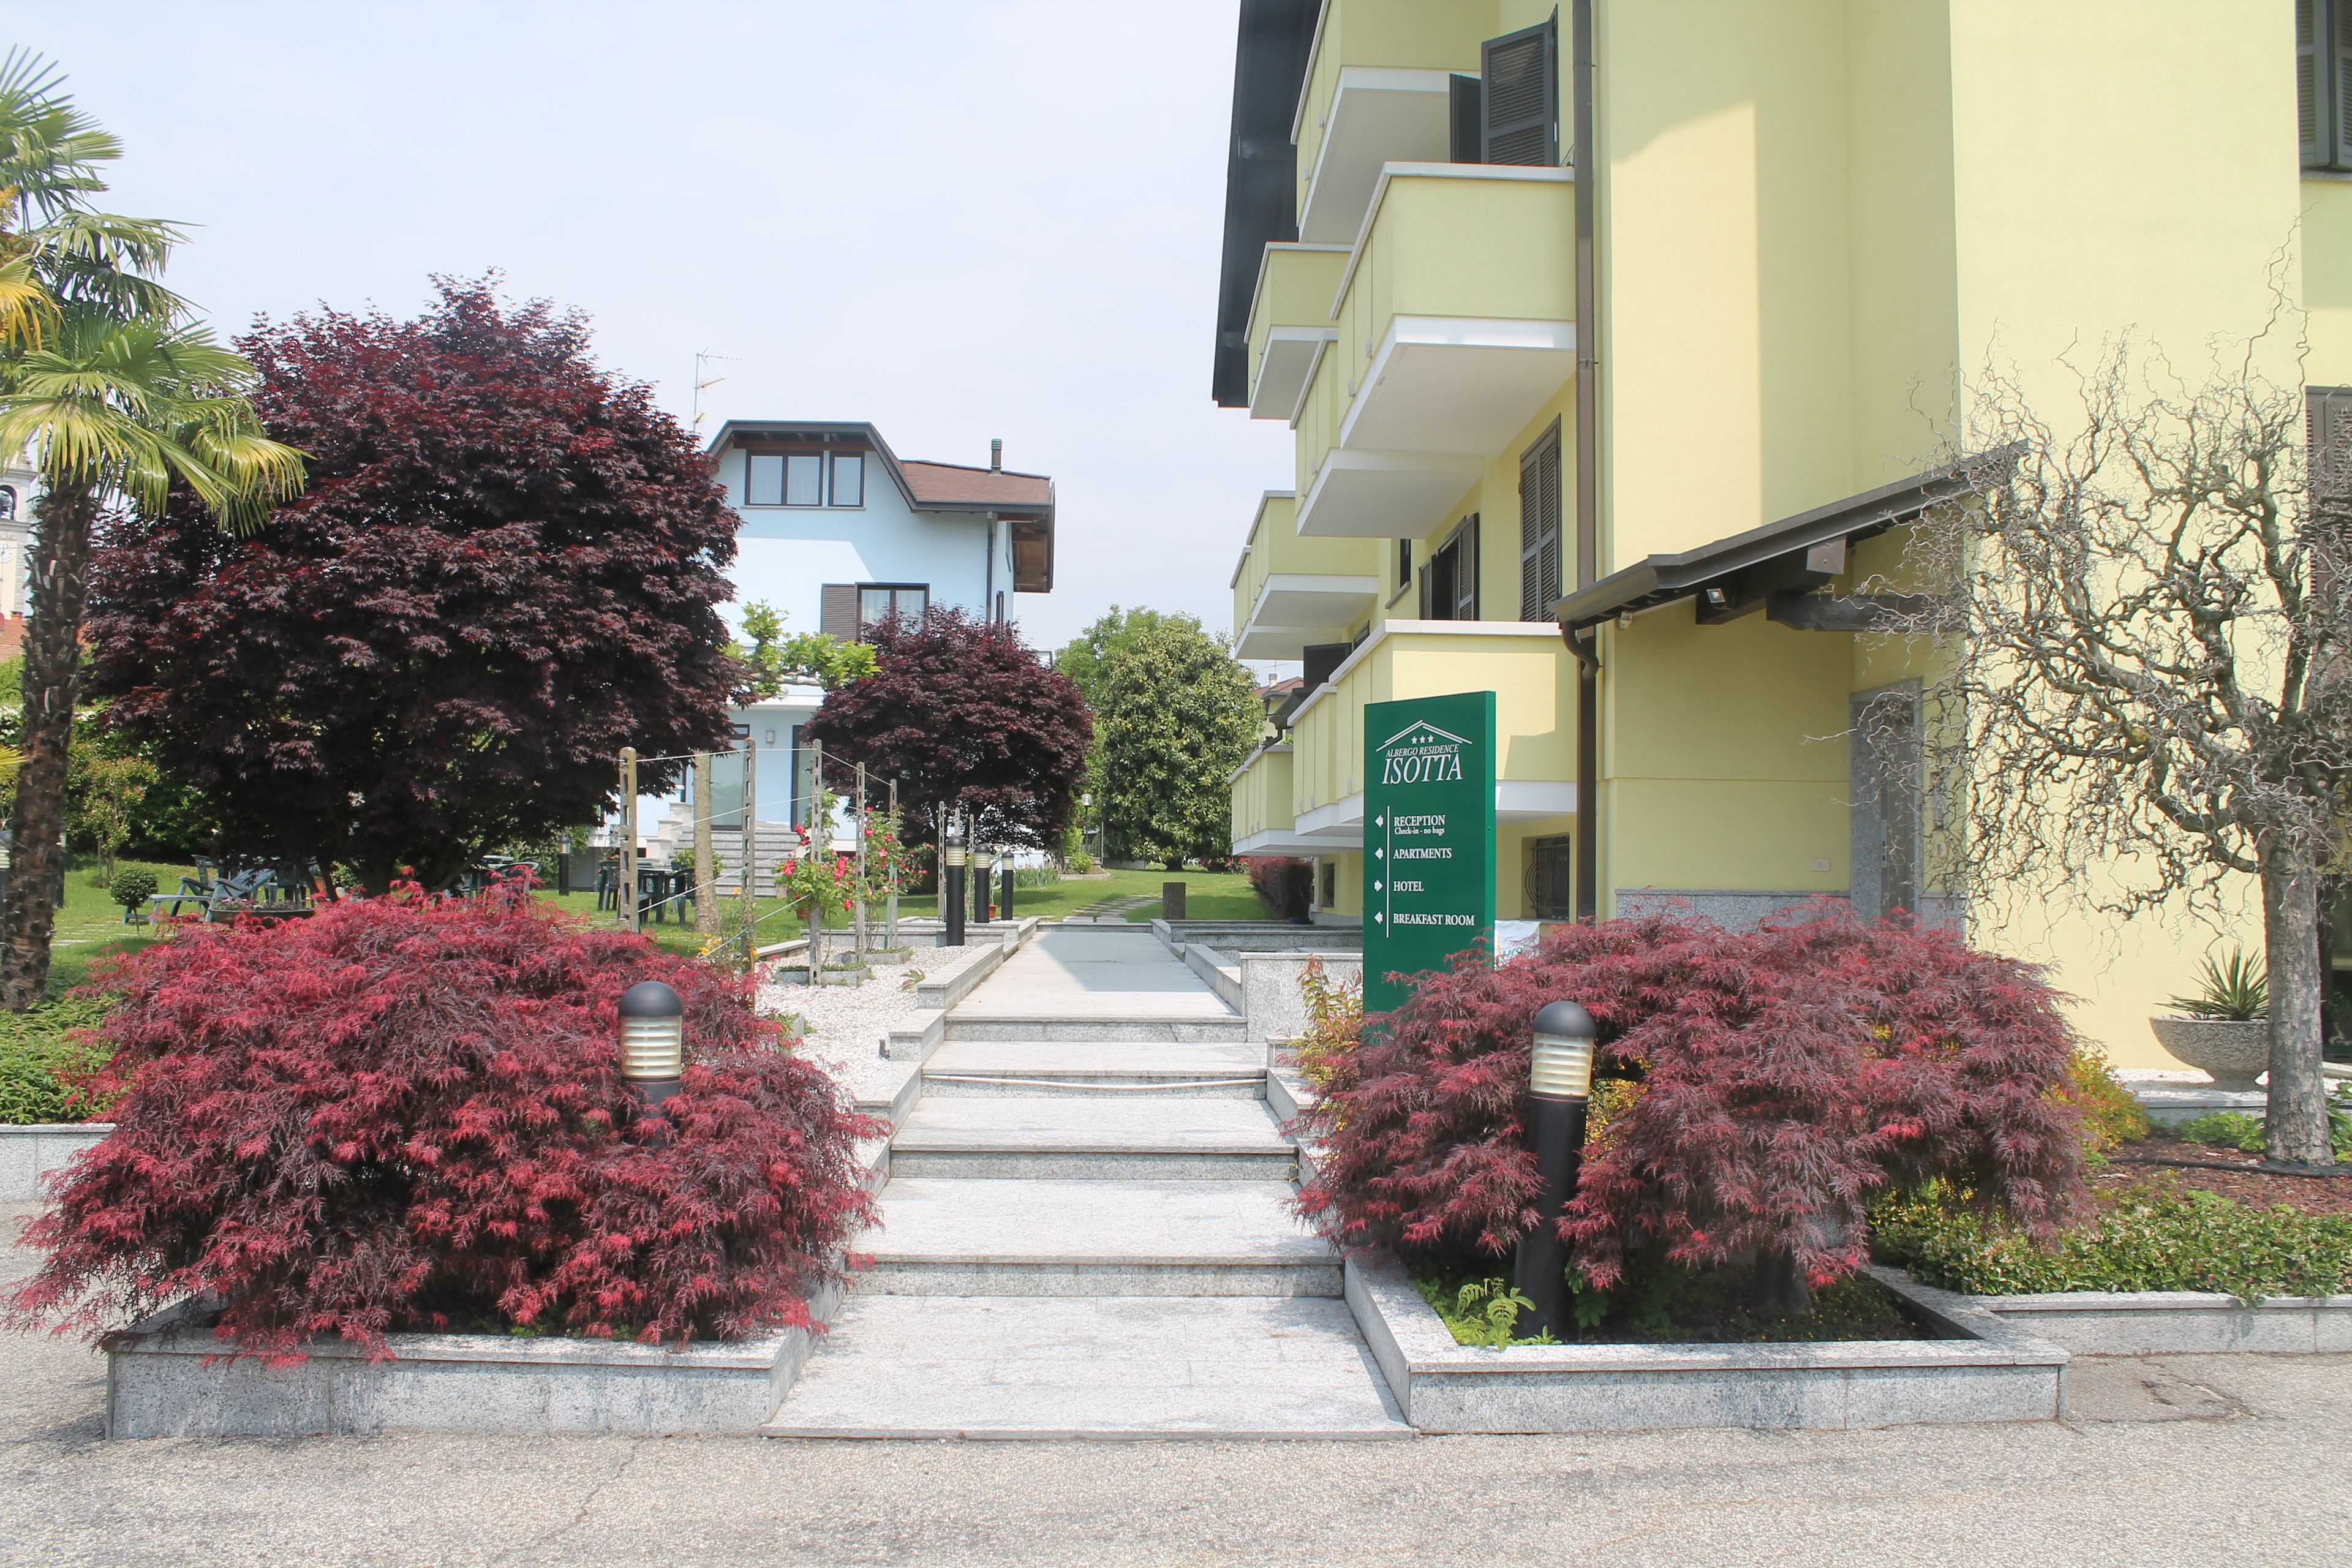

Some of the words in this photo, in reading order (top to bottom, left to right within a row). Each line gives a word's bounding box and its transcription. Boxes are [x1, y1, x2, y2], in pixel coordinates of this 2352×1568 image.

[1385, 747, 1418, 758] ALBERGO
[1419, 744, 1460, 755] RESIDENCE
[1381, 753, 1463, 785] ISOTTA
[1393, 815, 1446, 826] RECEPTION
[1432, 826, 1445, 836] bags
[1393, 847, 1452, 859] APARTMENTS
[1393, 881, 1424, 892] HOTEL
[1393, 913, 1443, 924] BREAKFAST
[1445, 914, 1475, 926] ROOM
